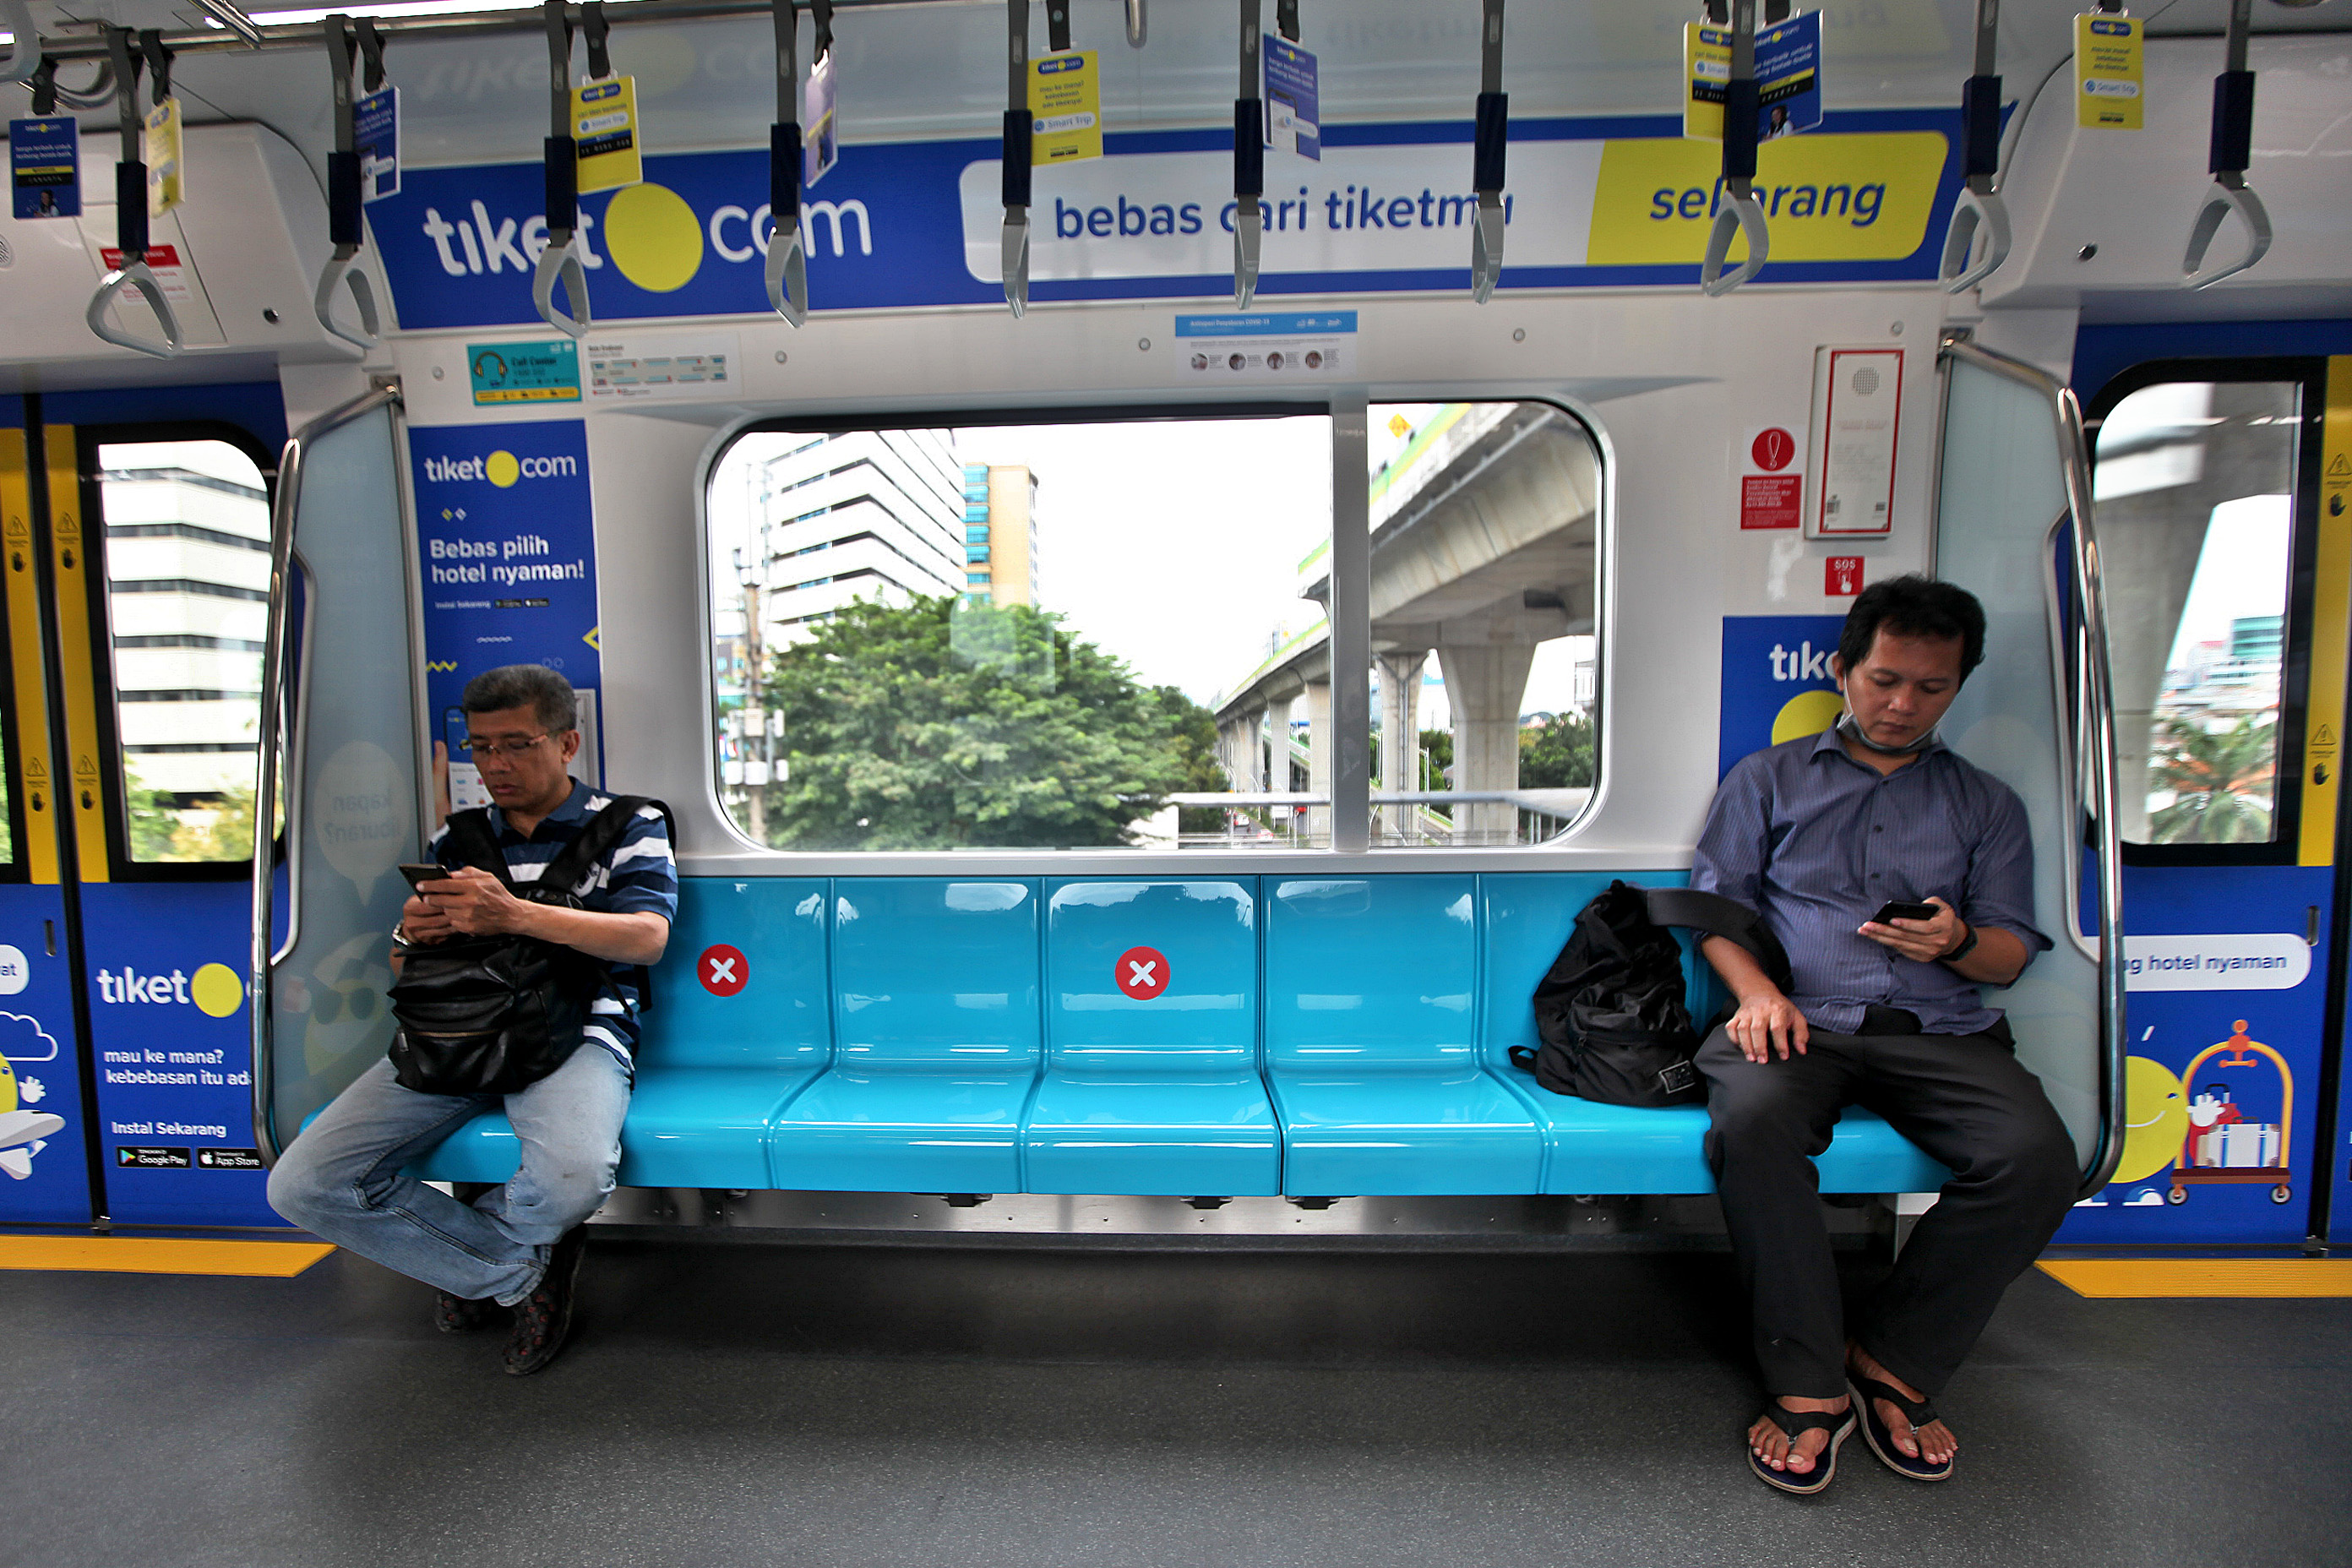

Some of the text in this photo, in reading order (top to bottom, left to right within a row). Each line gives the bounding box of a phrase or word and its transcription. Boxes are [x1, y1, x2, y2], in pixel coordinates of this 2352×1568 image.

[422, 199, 604, 277] tiket
[1055, 193, 1204, 240] bebas
[423, 455, 577, 482] tiket com
[429, 534, 550, 561] Bebas pilih
[431, 558, 585, 586] hotel nyaman!
[1833, 558, 1856, 571] SOS
[1769, 640, 1839, 682] tik
[2148, 954, 2201, 971] hotel
[2204, 955, 2288, 974] nyaman
[95, 966, 191, 1004] tiket
[104, 1048, 225, 1064] mau ke mana?
[105, 1069, 195, 1086] kebebasan
[200, 1070, 224, 1086] itu
[112, 1120, 227, 1138] Instal Sekarang
[137, 1155, 188, 1167] Google Play
[215, 1157, 260, 1167] App Store
